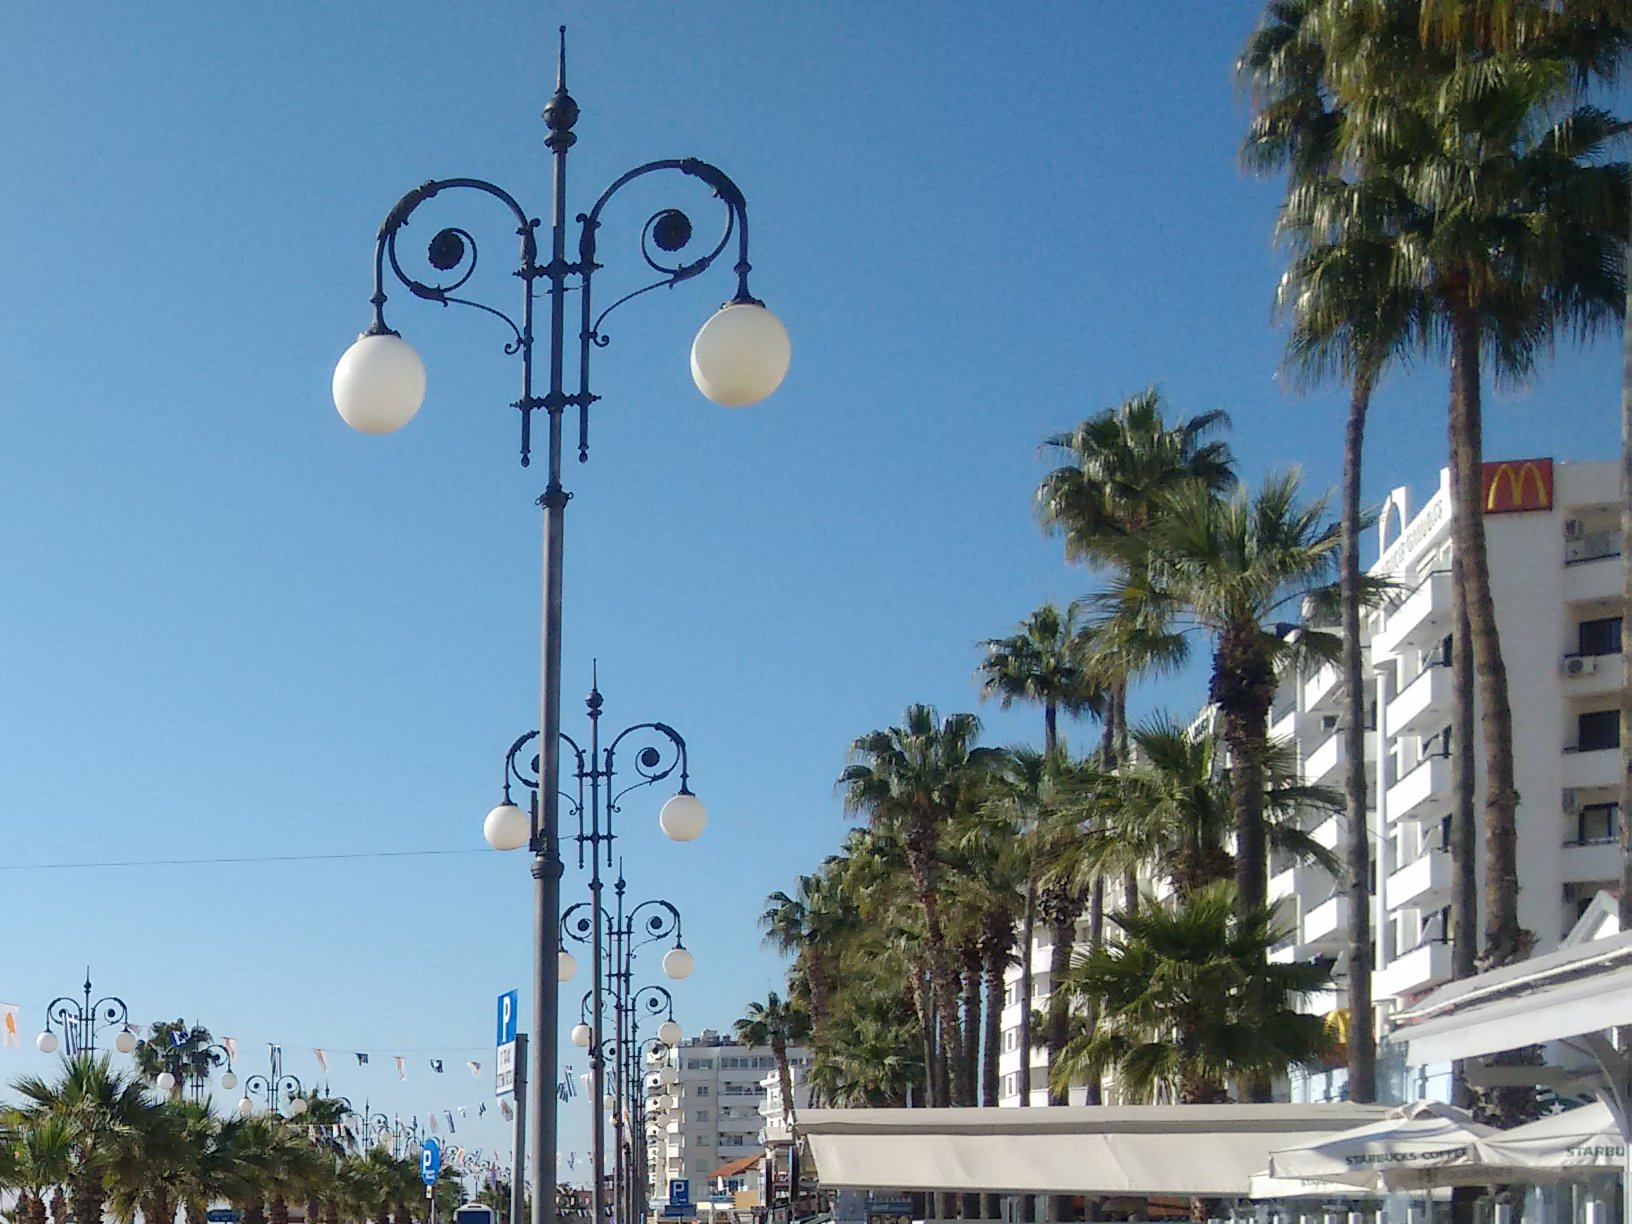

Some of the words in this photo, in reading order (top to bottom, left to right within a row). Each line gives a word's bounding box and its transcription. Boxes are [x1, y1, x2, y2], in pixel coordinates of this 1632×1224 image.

[502, 995, 512, 1043] P
[422, 1149, 432, 1175] P
[1345, 1151, 1418, 1166] STARBUCKS
[672, 1181, 685, 1197] P
